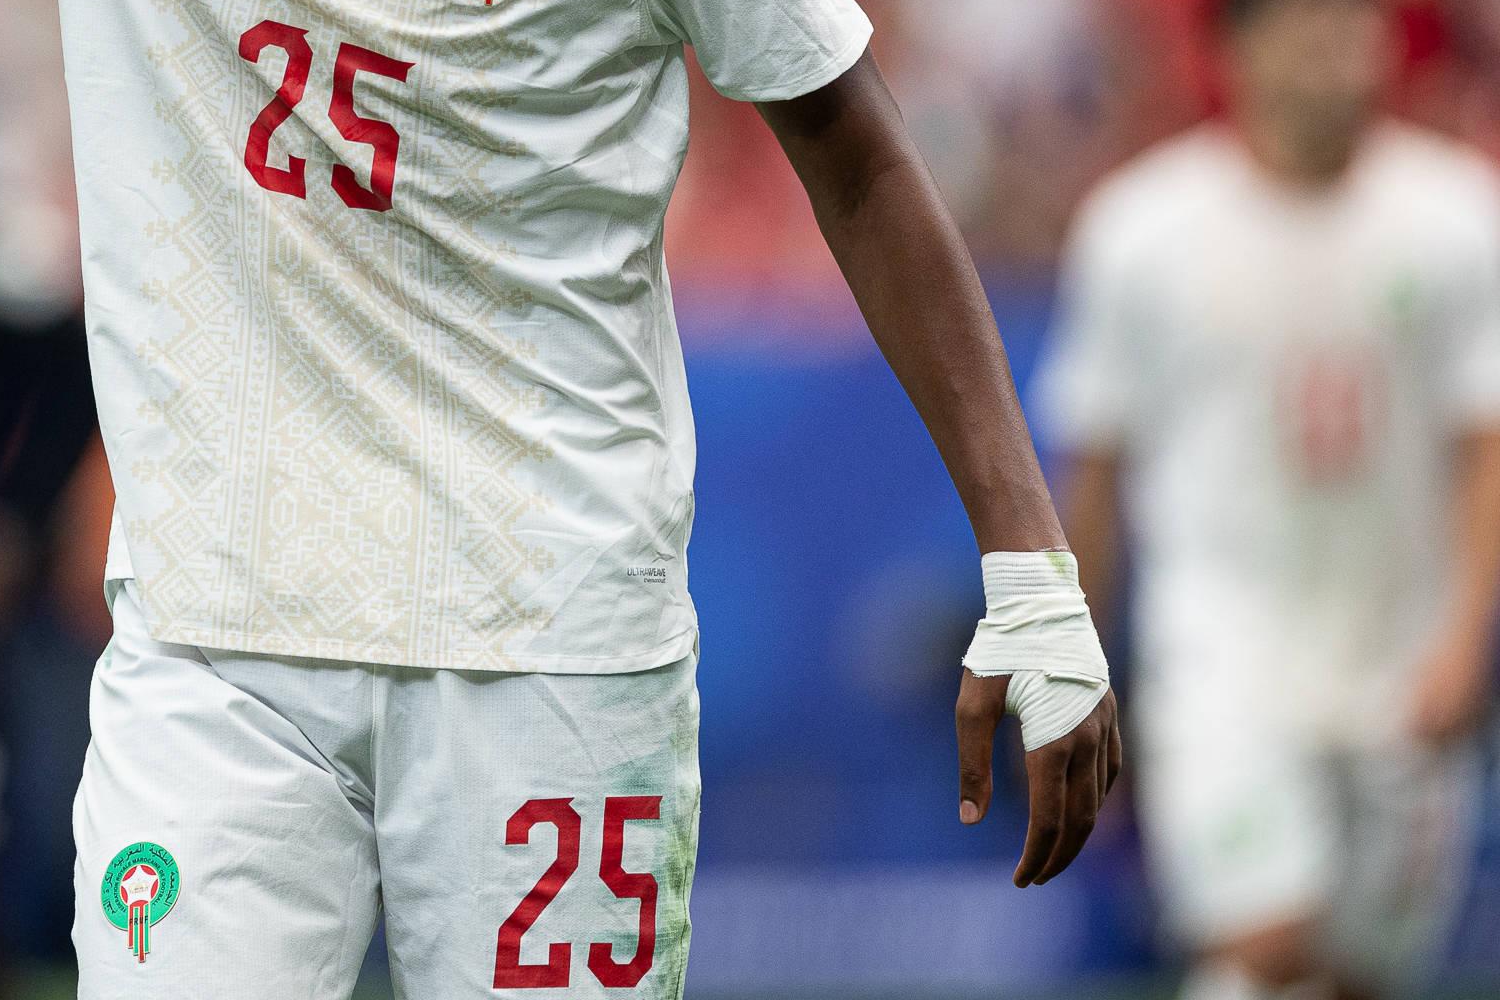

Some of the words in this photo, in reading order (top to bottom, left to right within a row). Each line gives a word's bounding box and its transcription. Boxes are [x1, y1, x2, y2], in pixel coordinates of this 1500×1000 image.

[238, 19, 417, 213] 25
[626, 567, 666, 577] ULTRAWEAVE
[132, 857, 160, 871] MAROCAINE
[153, 878, 167, 906] FOOTBALL
[493, 796, 664, 989] 25
